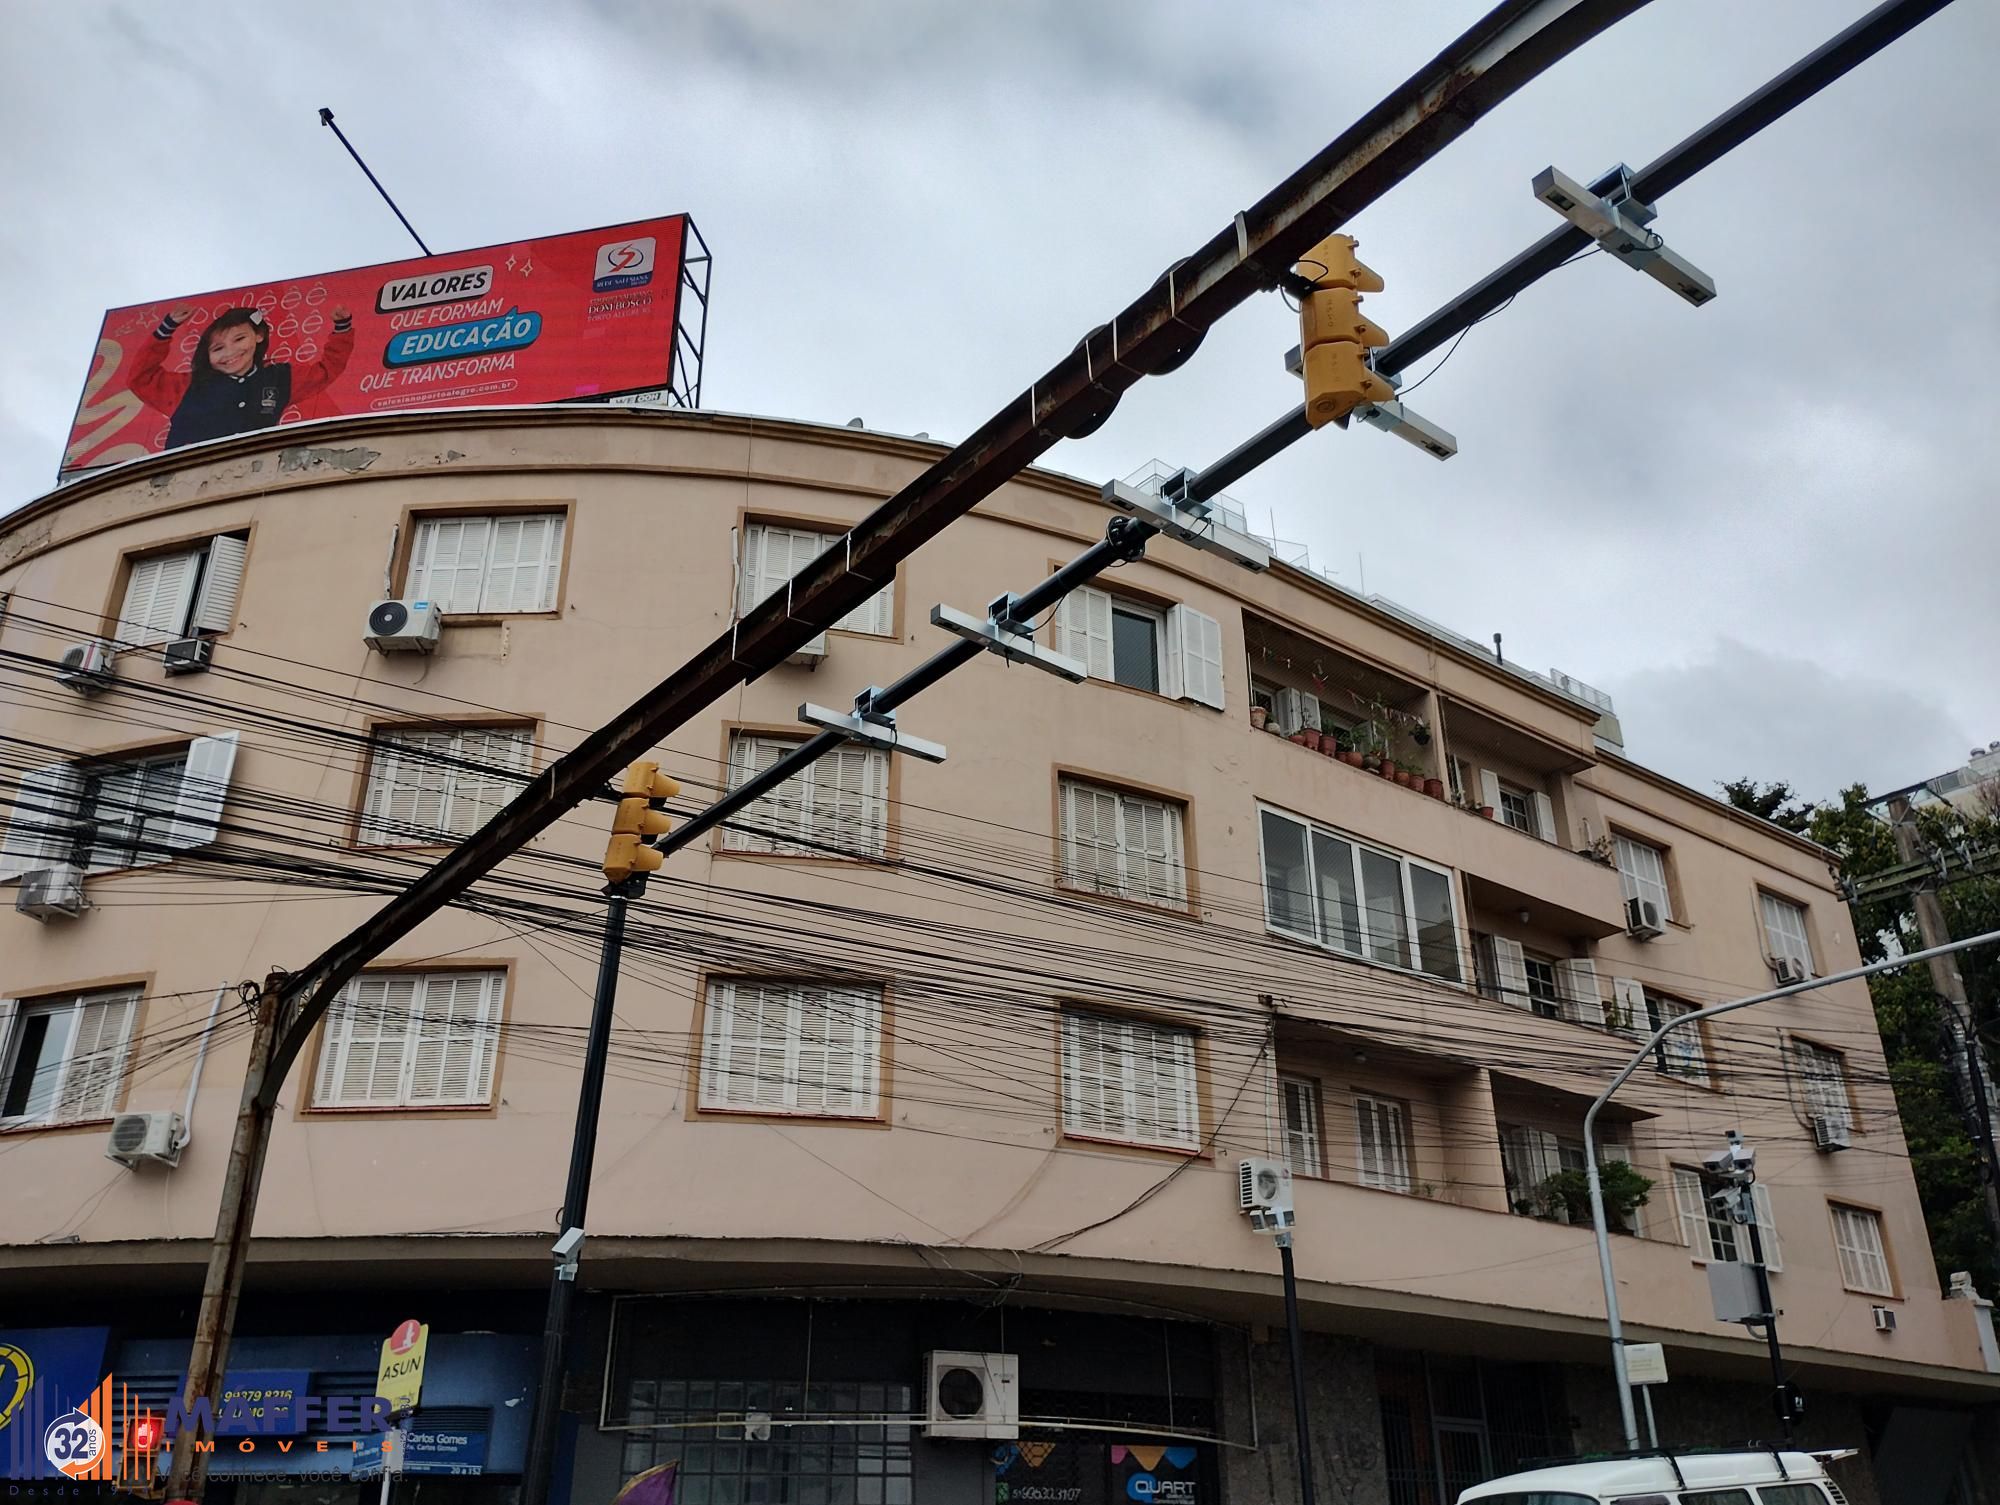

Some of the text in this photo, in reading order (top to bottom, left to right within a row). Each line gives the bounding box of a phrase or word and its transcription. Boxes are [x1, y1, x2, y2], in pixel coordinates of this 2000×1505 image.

[391, 272, 488, 302] VALORES
[390, 298, 504, 331] QUE FORMAM
[588, 296, 654, 315] DOM BOSCO
[401, 315, 532, 356] EDUCAÇÃO
[359, 353, 515, 393] QUE TRANSFORMA
[382, 1356, 421, 1382] ASUN
[407, 1432, 468, 1445] Carlos Gomes
[1135, 1480, 1196, 1495] QUART
